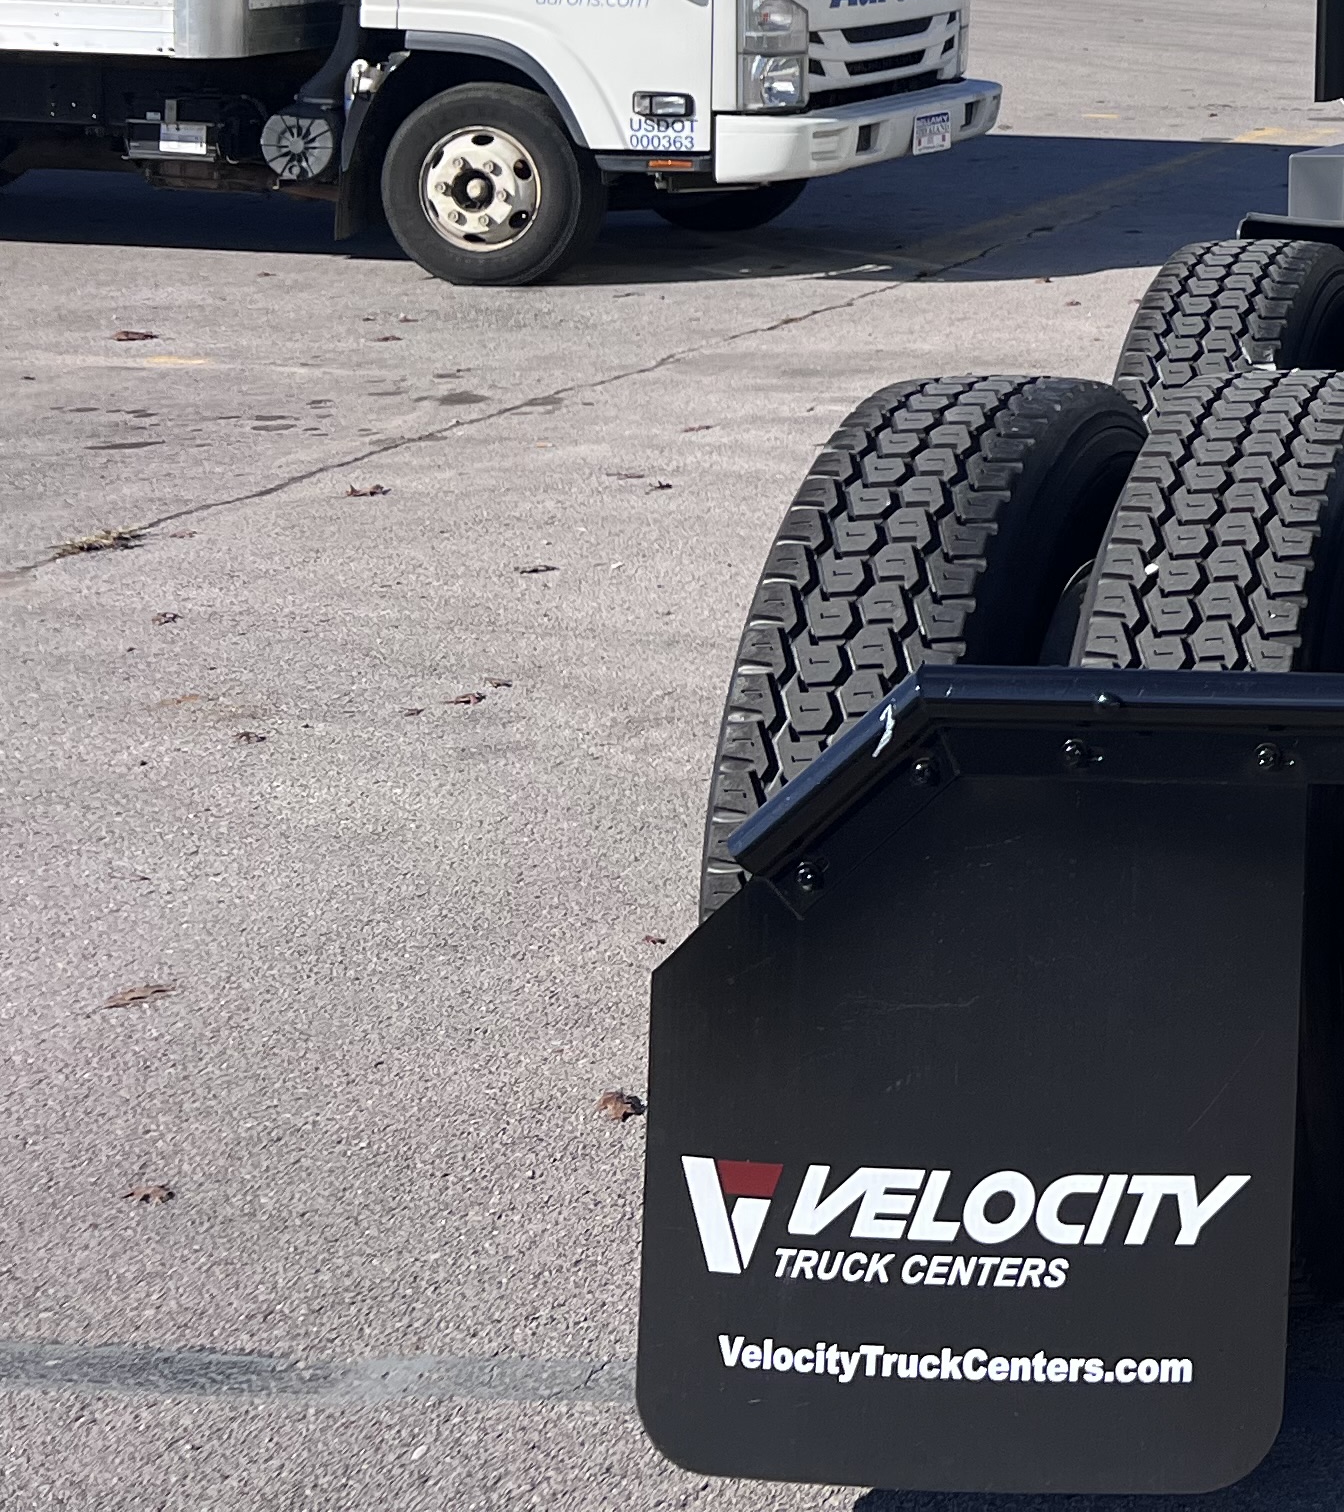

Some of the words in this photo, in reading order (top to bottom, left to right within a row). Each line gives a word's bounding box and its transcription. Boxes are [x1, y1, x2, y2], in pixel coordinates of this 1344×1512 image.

[629, 117, 699, 134] USDOT
[629, 134, 695, 151] 000363
[787, 1163, 1253, 1247] VELOCITY
[773, 1247, 897, 1284] TRUCK
[901, 1253, 1070, 1289] CENTERS
[717, 1334, 1194, 1384] VelocityTruckCenters.com
